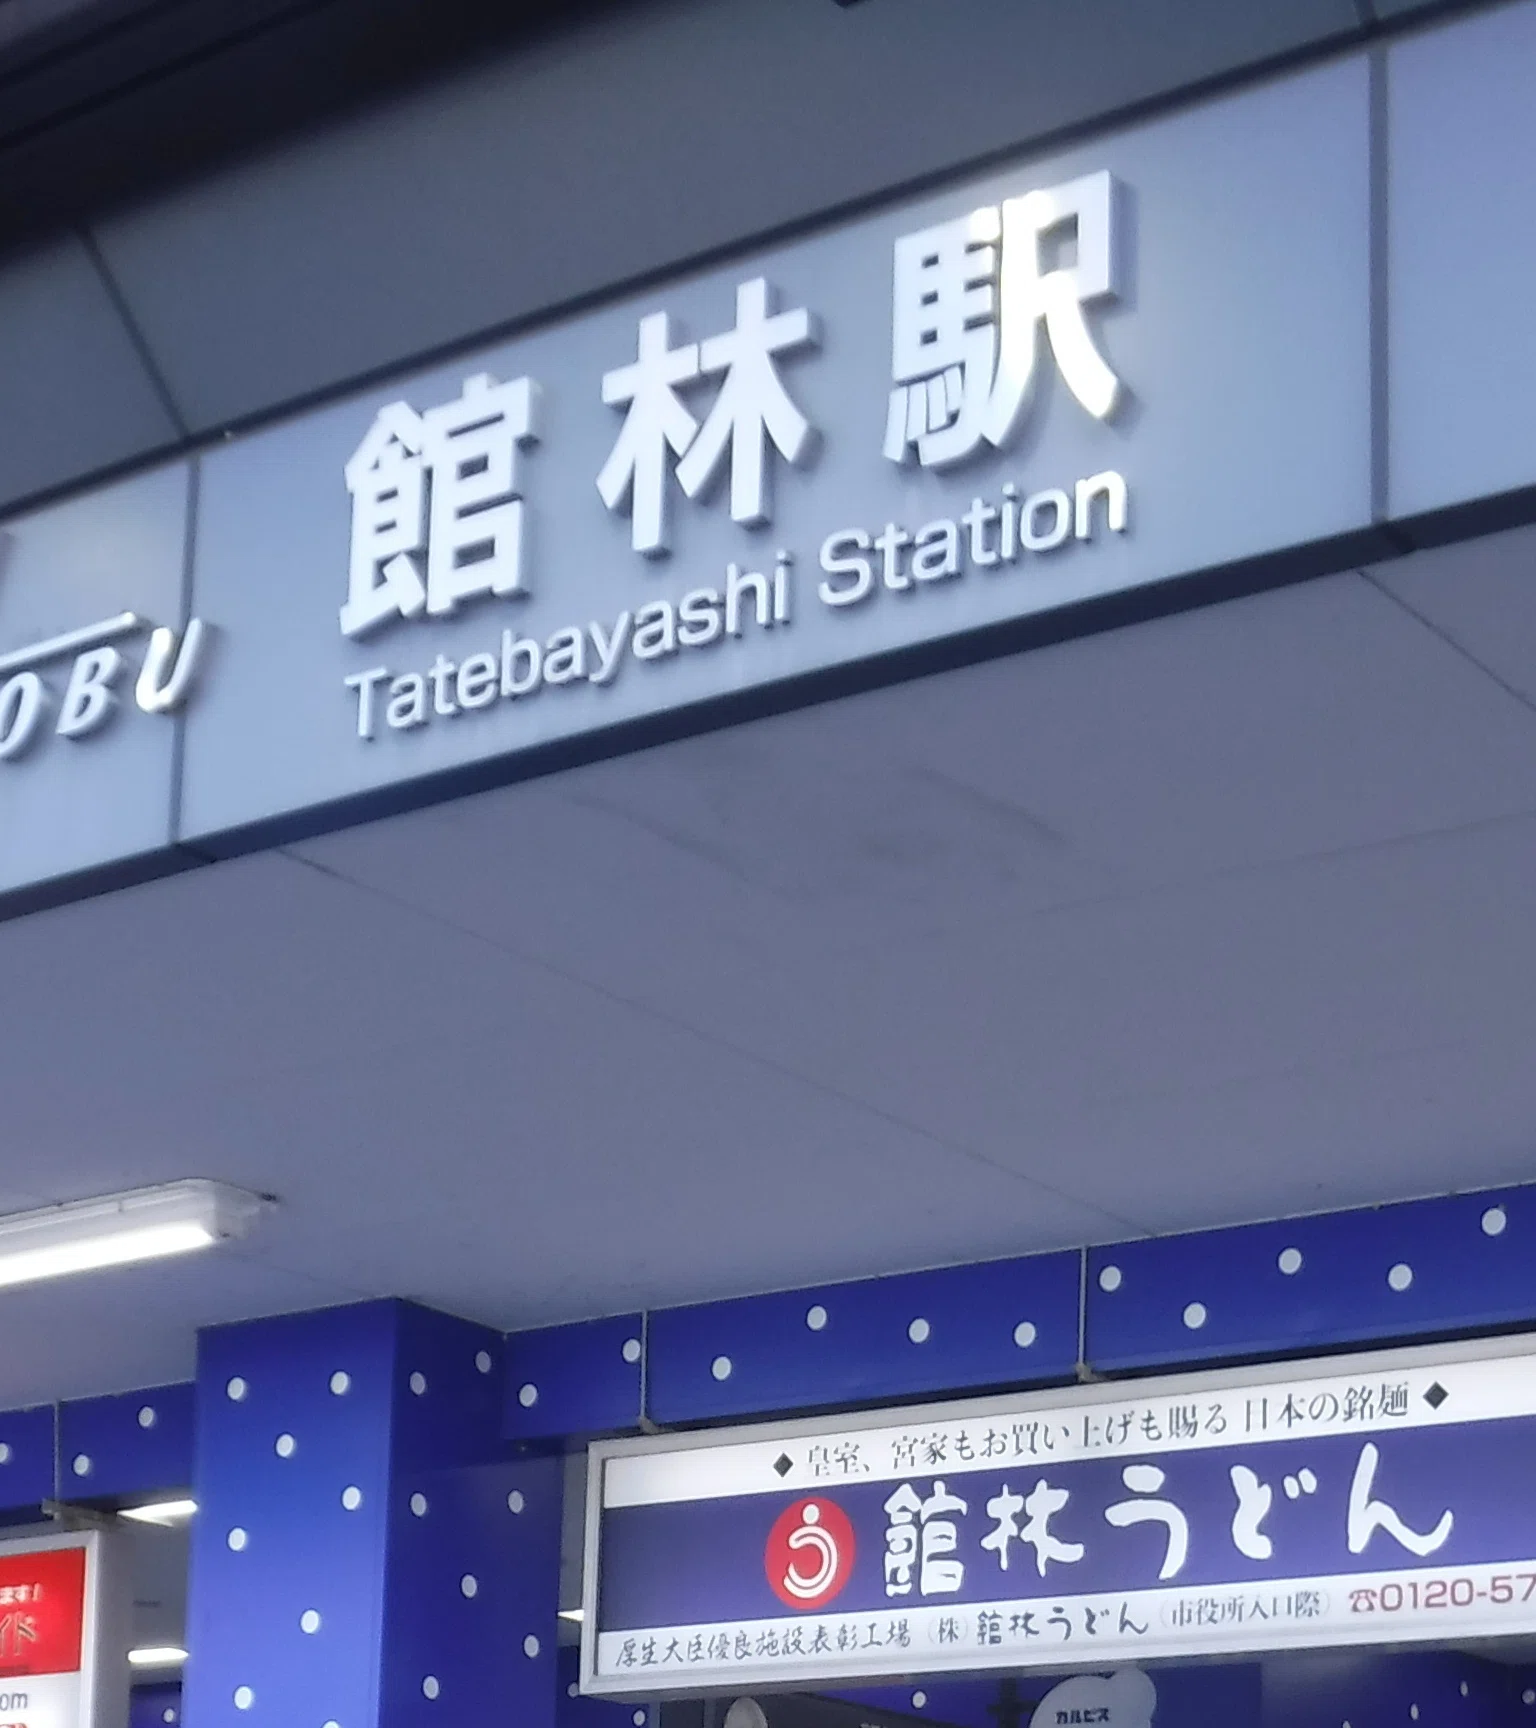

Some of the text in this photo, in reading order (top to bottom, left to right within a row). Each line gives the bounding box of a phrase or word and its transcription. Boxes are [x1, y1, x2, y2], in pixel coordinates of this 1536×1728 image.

[338, 170, 1126, 637] 館林駅
[345, 468, 1130, 740] Tatebayashi Station
[883, 1442, 1454, 1597] 館林うどん
[615, 1620, 912, 1668] 厚生大臣優良施設表彰工場
[976, 1605, 1149, 1646] 館林うどん
[1055, 1707, 1110, 1725] カルピス
